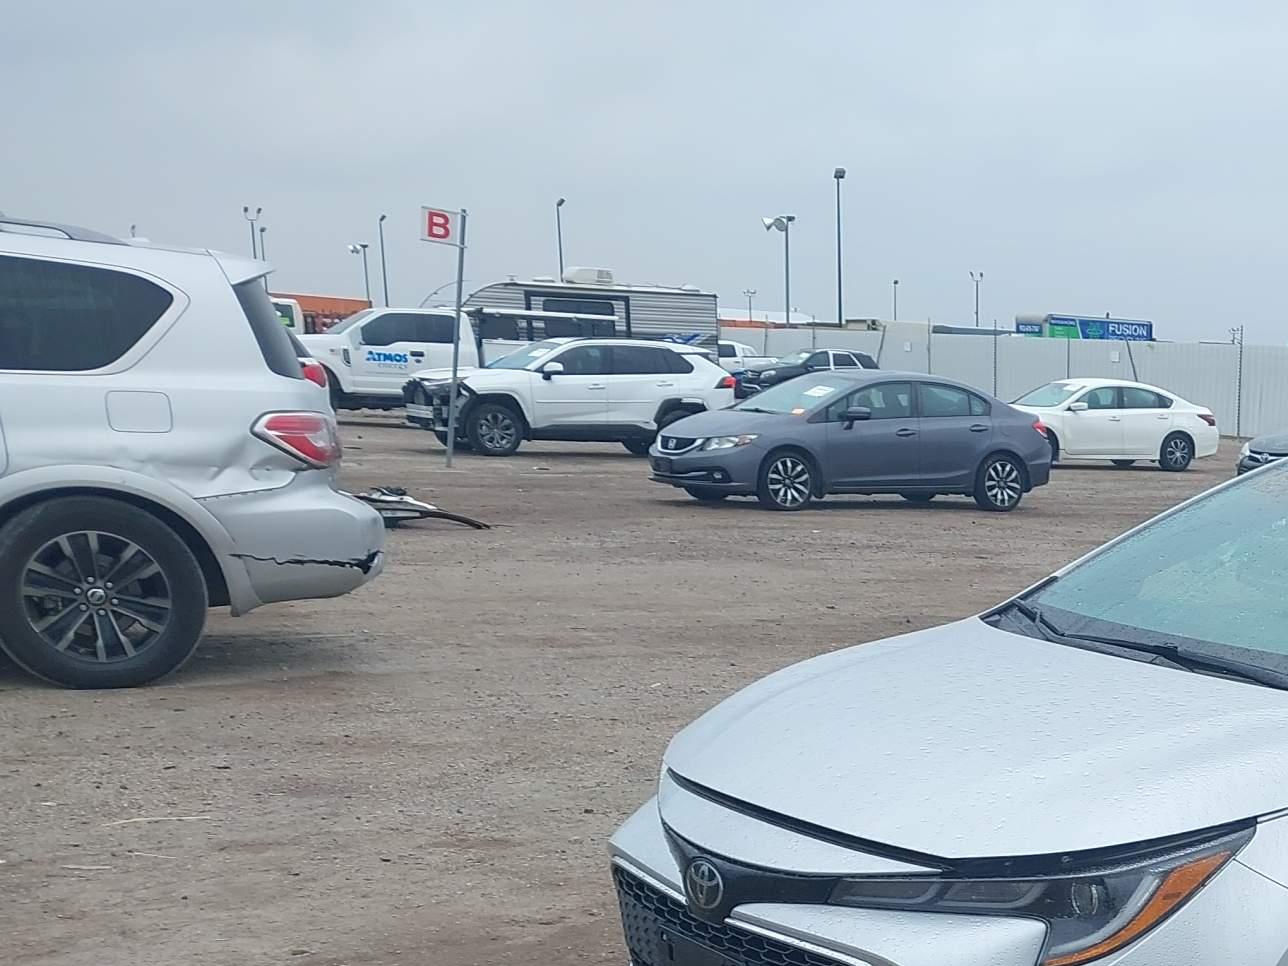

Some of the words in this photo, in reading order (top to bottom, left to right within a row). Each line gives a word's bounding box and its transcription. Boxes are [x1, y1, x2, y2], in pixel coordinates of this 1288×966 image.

[427, 210, 450, 240] B
[1108, 323, 1147, 337] FUSION
[366, 350, 408, 363] ATMOS
